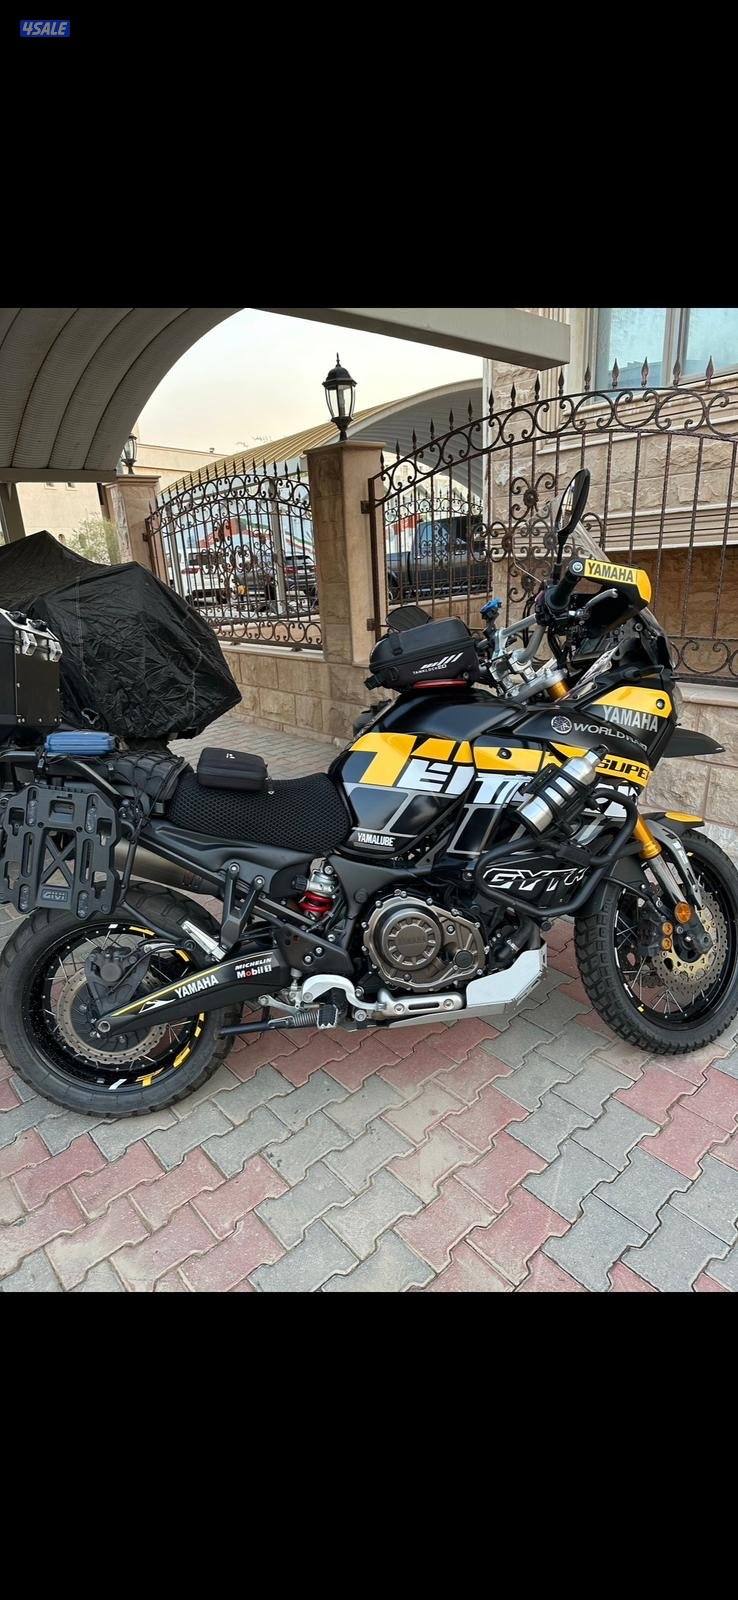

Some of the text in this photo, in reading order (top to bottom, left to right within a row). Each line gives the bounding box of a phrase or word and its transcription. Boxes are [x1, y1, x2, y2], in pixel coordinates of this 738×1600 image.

[587, 562, 634, 583] YAMAHA
[602, 705, 659, 733] YAMAHA
[573, 722, 626, 739] WORLD
[597, 758, 650, 781] SUPE
[357, 832, 396, 847] YAMALUBE
[42, 890, 65, 901] GIVI
[234, 957, 273, 971] MICHELIN
[236, 965, 264, 979] Mobil
[174, 973, 219, 1000] YAMAHA
